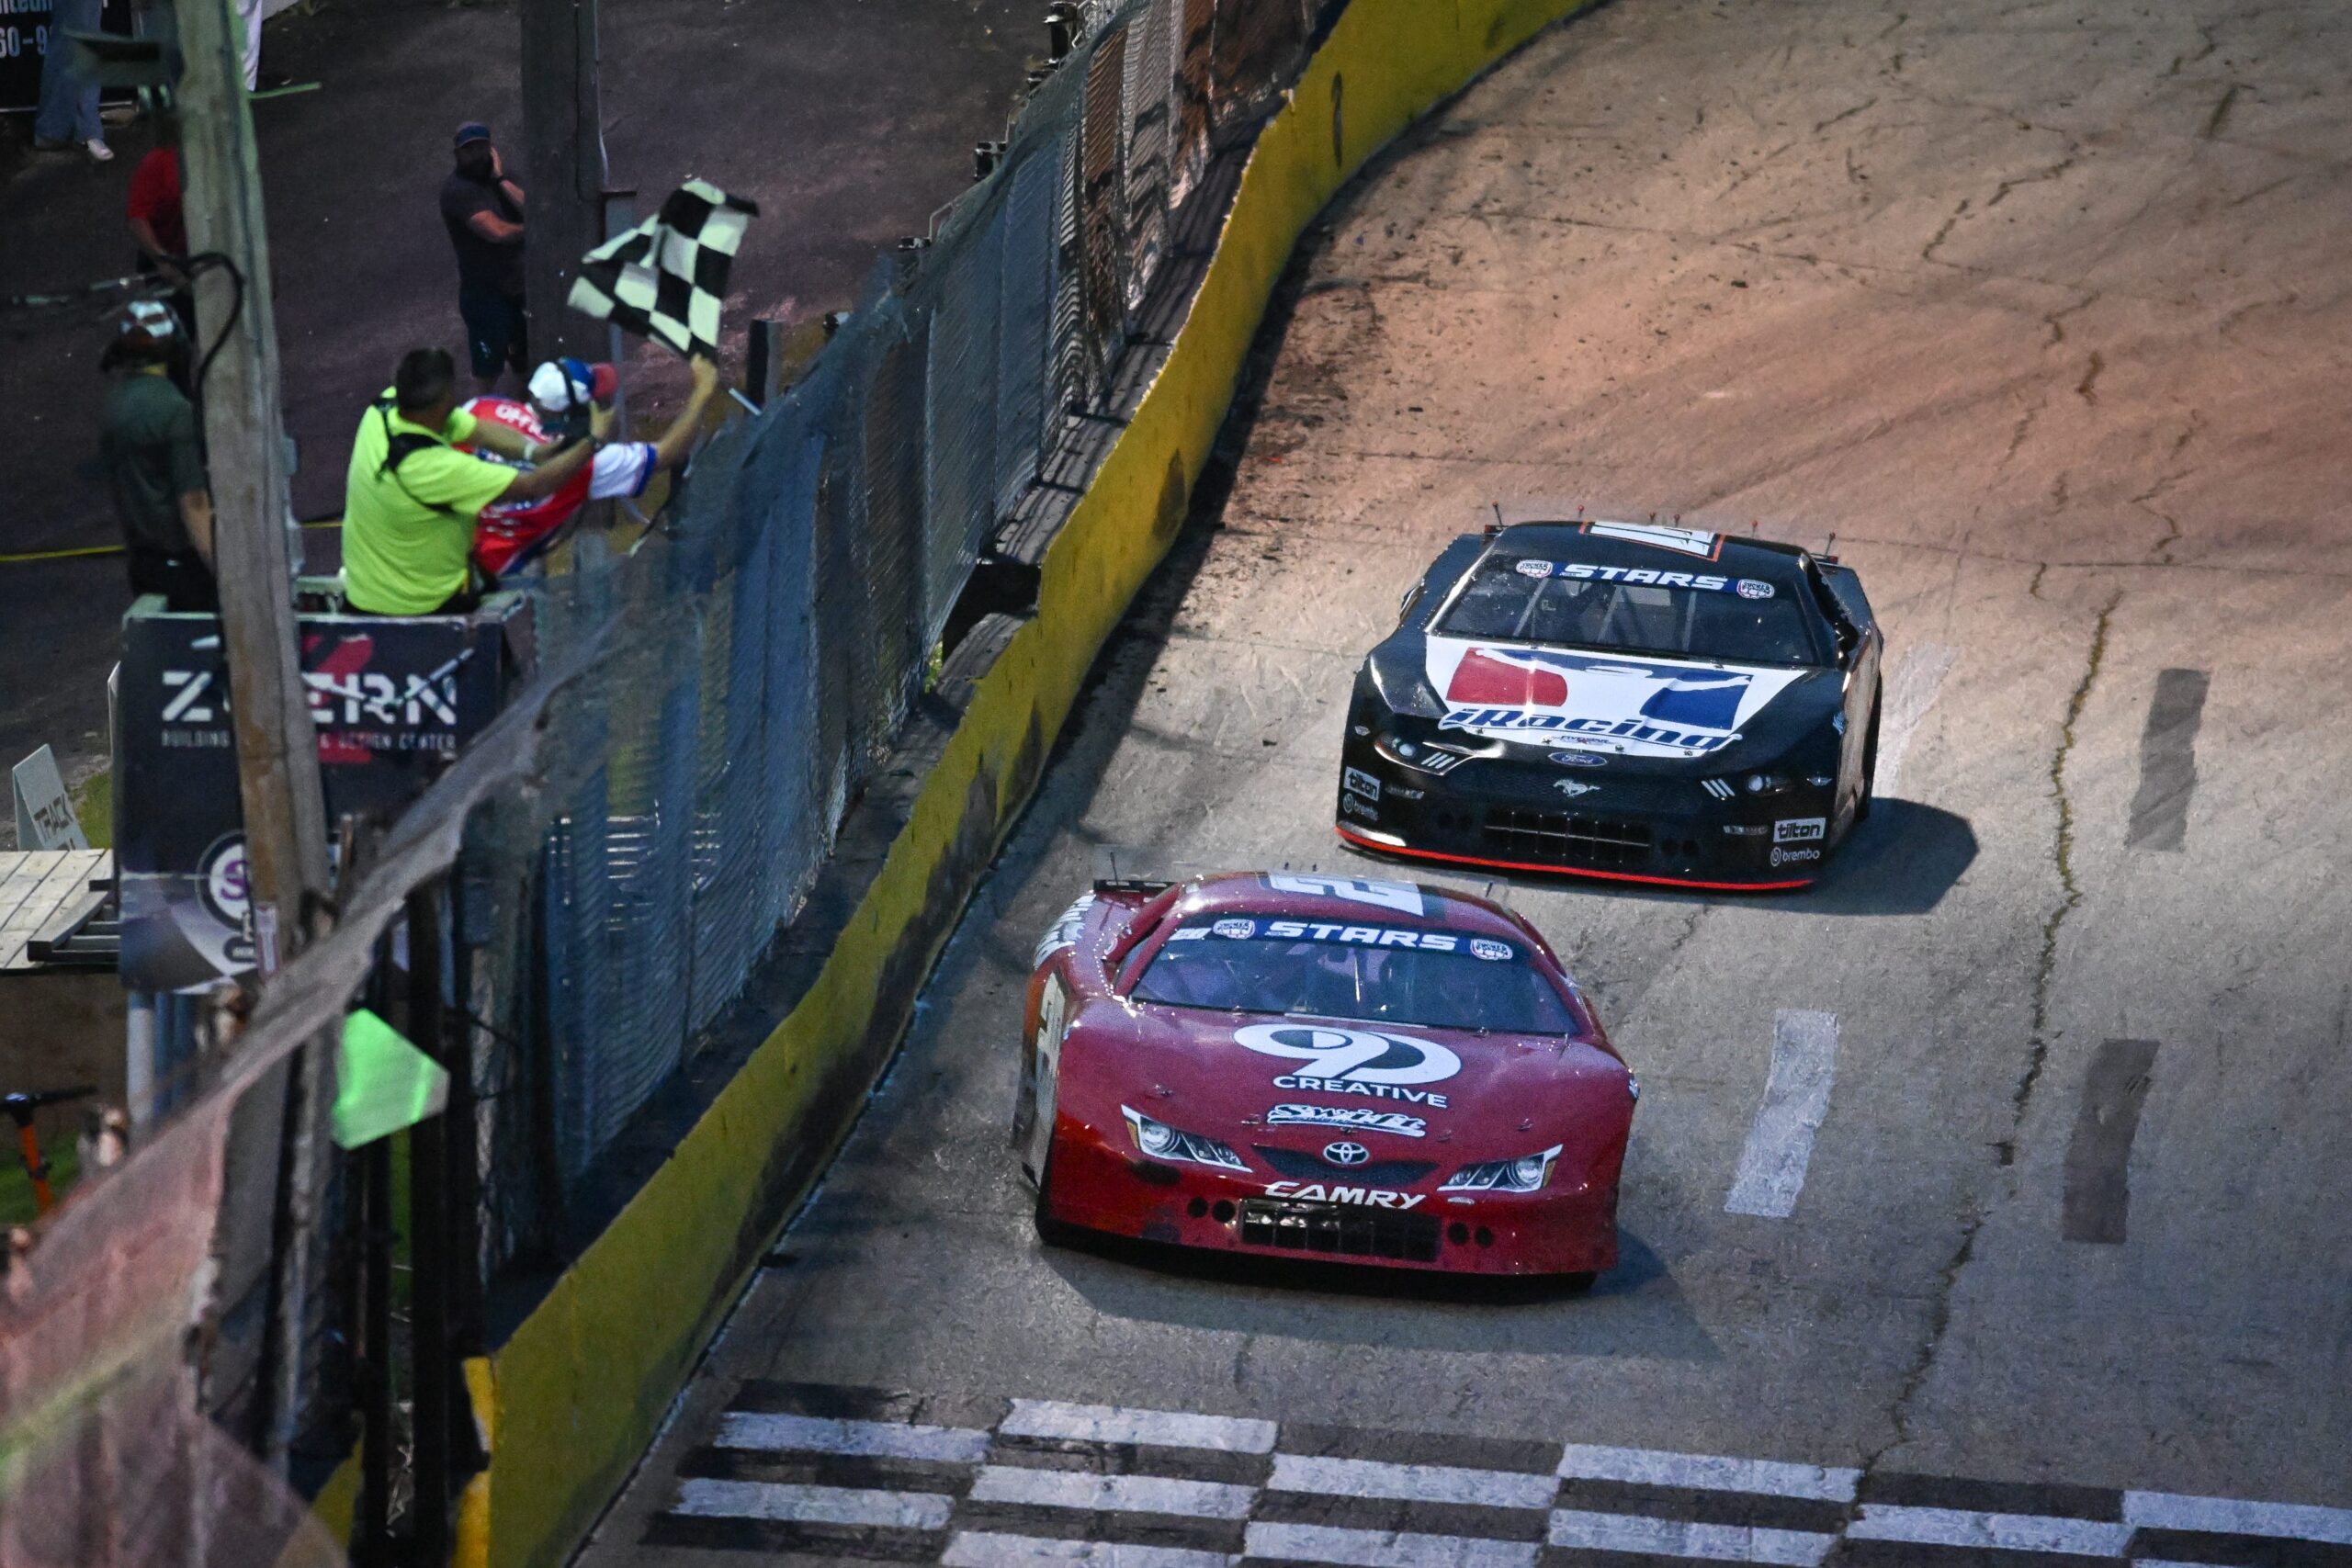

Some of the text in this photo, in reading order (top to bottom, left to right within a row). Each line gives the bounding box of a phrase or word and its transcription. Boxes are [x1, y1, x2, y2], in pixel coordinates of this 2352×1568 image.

[1561, 563, 1728, 591] STARS
[161, 670, 458, 726] ZERN
[1441, 708, 1730, 751] iRacing
[1777, 822, 1821, 840] tilton
[1782, 848, 1821, 863] brembo
[1268, 921, 1459, 951] STARS
[1272, 1076, 1448, 1109] CREATIVE
[1264, 1180, 1427, 1210] CAMRY
